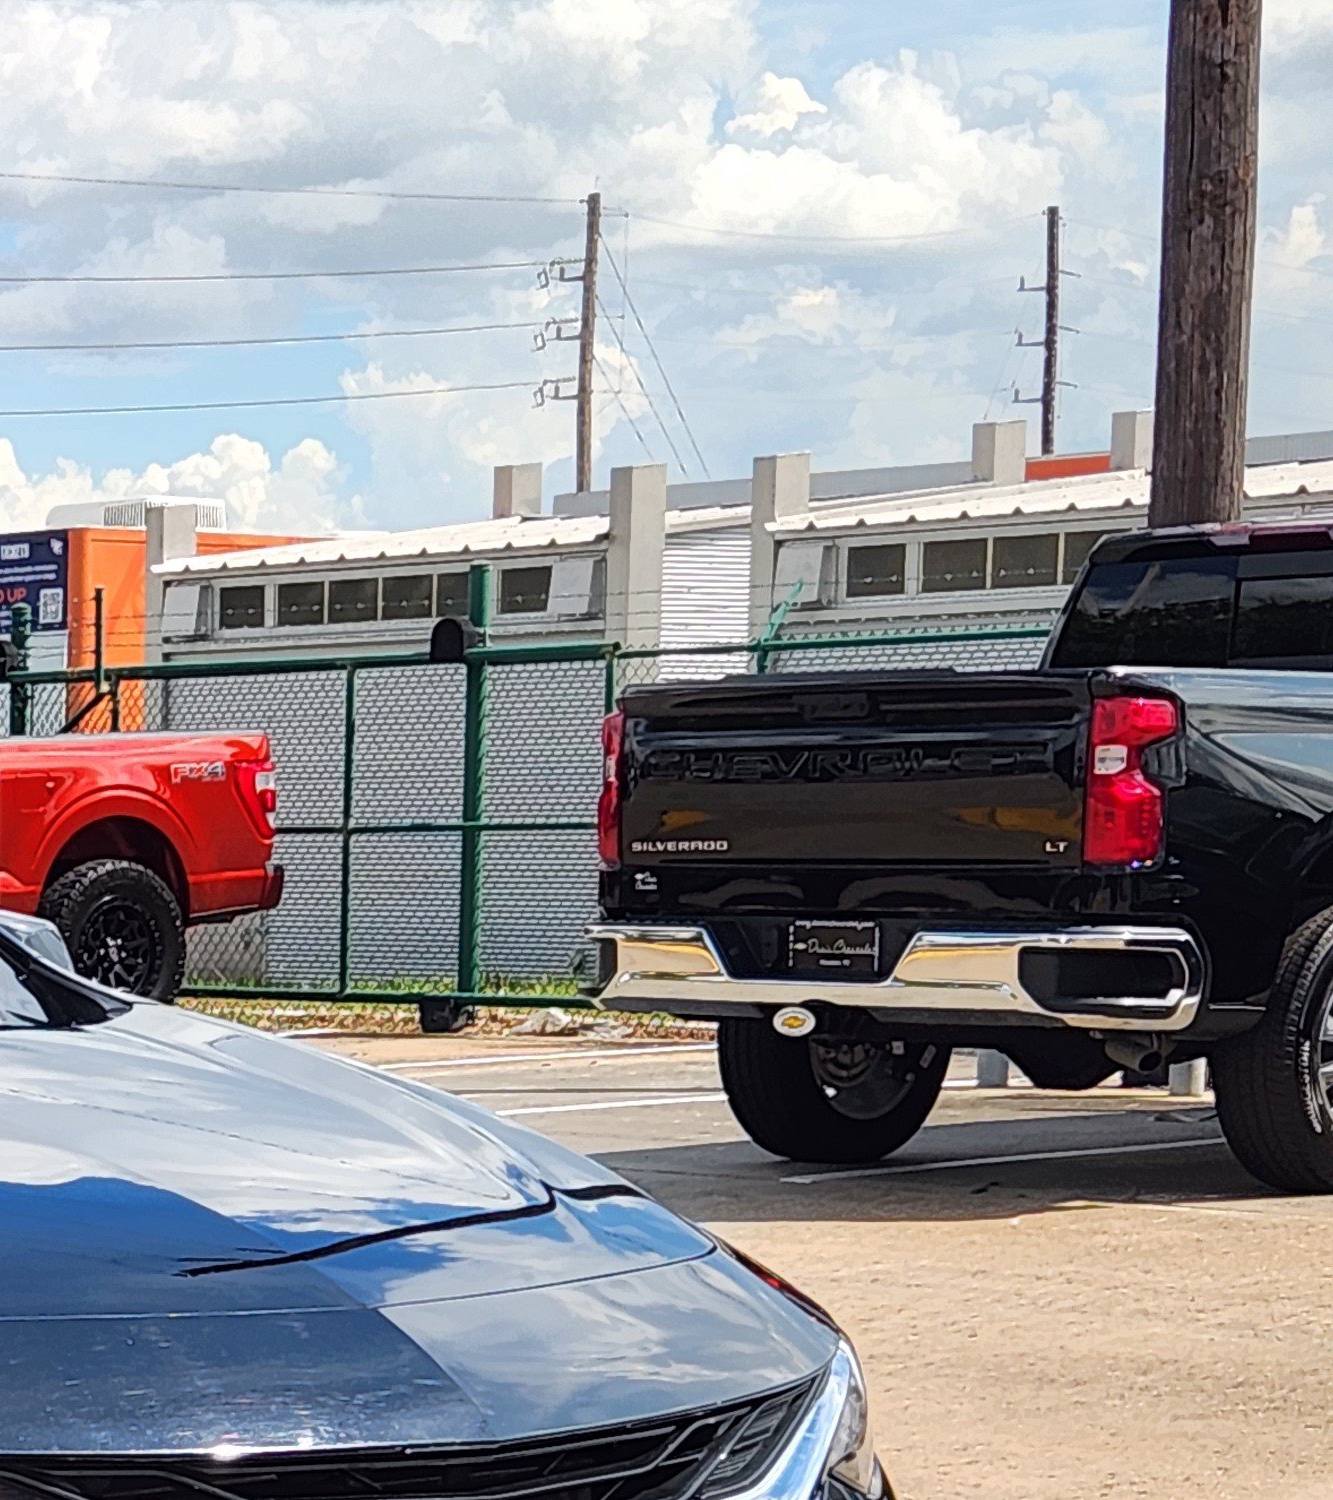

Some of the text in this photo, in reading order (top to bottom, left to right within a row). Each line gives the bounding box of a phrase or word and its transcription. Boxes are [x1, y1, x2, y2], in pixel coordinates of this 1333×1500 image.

[7, 587, 27, 602] UP
[170, 760, 226, 784] FX4
[631, 840, 728, 852] SILVERADO
[1045, 841, 1069, 853] LT
